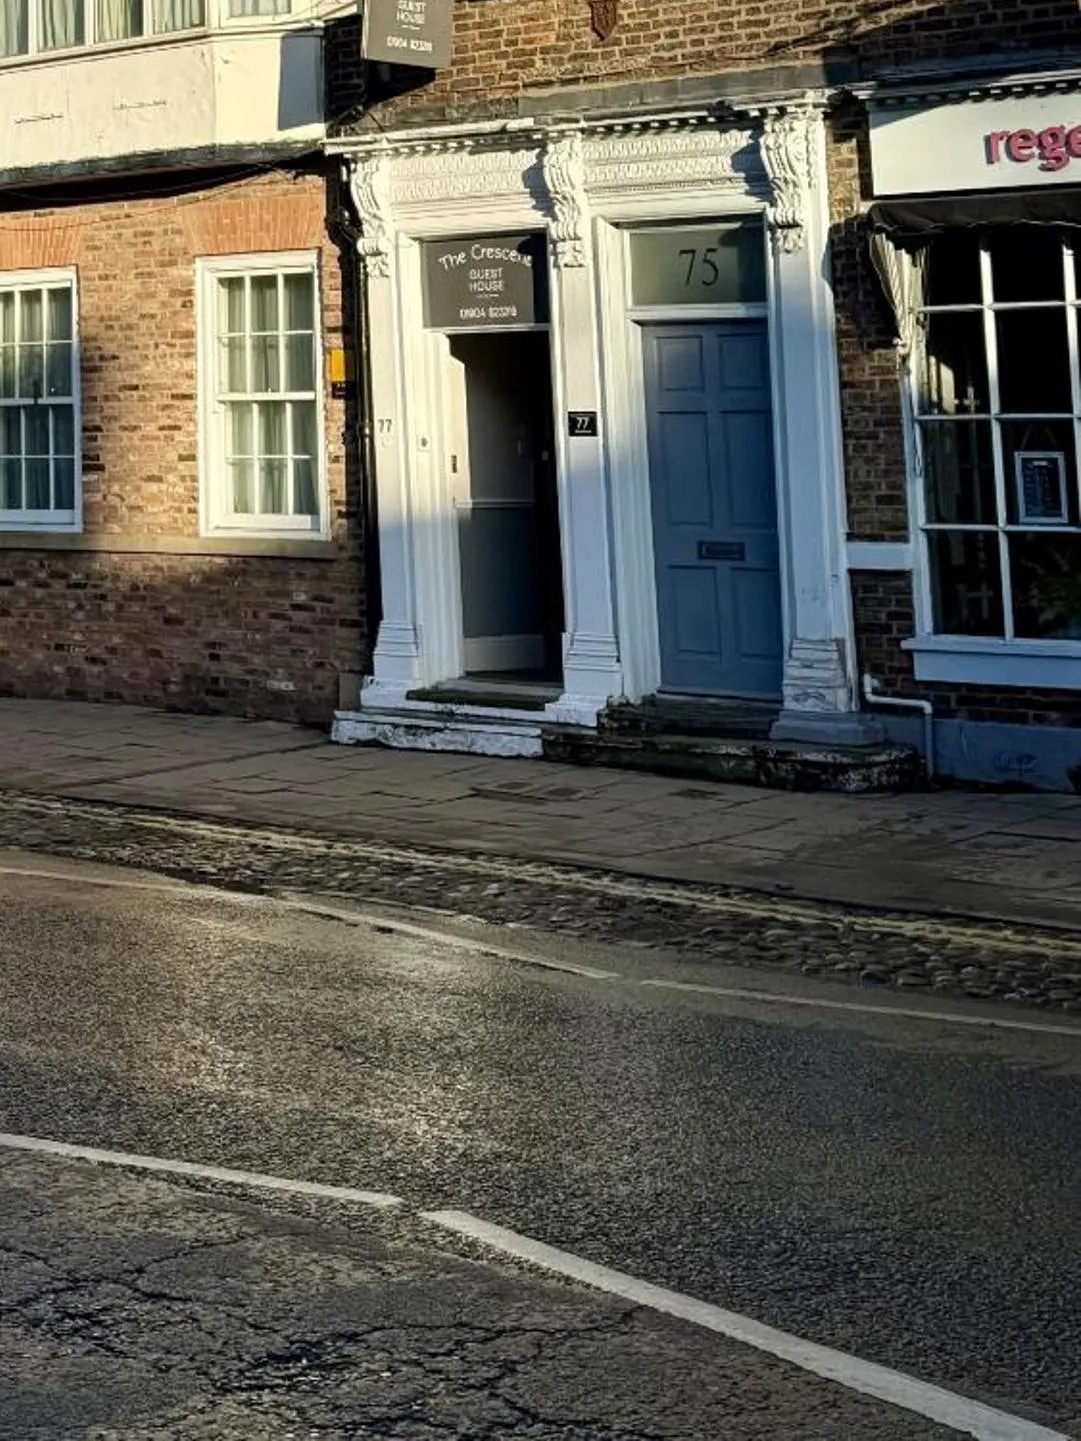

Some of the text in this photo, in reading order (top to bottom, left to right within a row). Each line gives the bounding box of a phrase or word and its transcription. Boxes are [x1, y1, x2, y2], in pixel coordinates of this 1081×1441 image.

[397, 11, 425, 24] HOUSE
[438, 251, 467, 270] The
[679, 248, 719, 287] 75
[469, 267, 503, 280] GUEST
[469, 280, 504, 292] HOUSE
[377, 418, 392, 433] 77
[576, 416, 590, 430] 77
